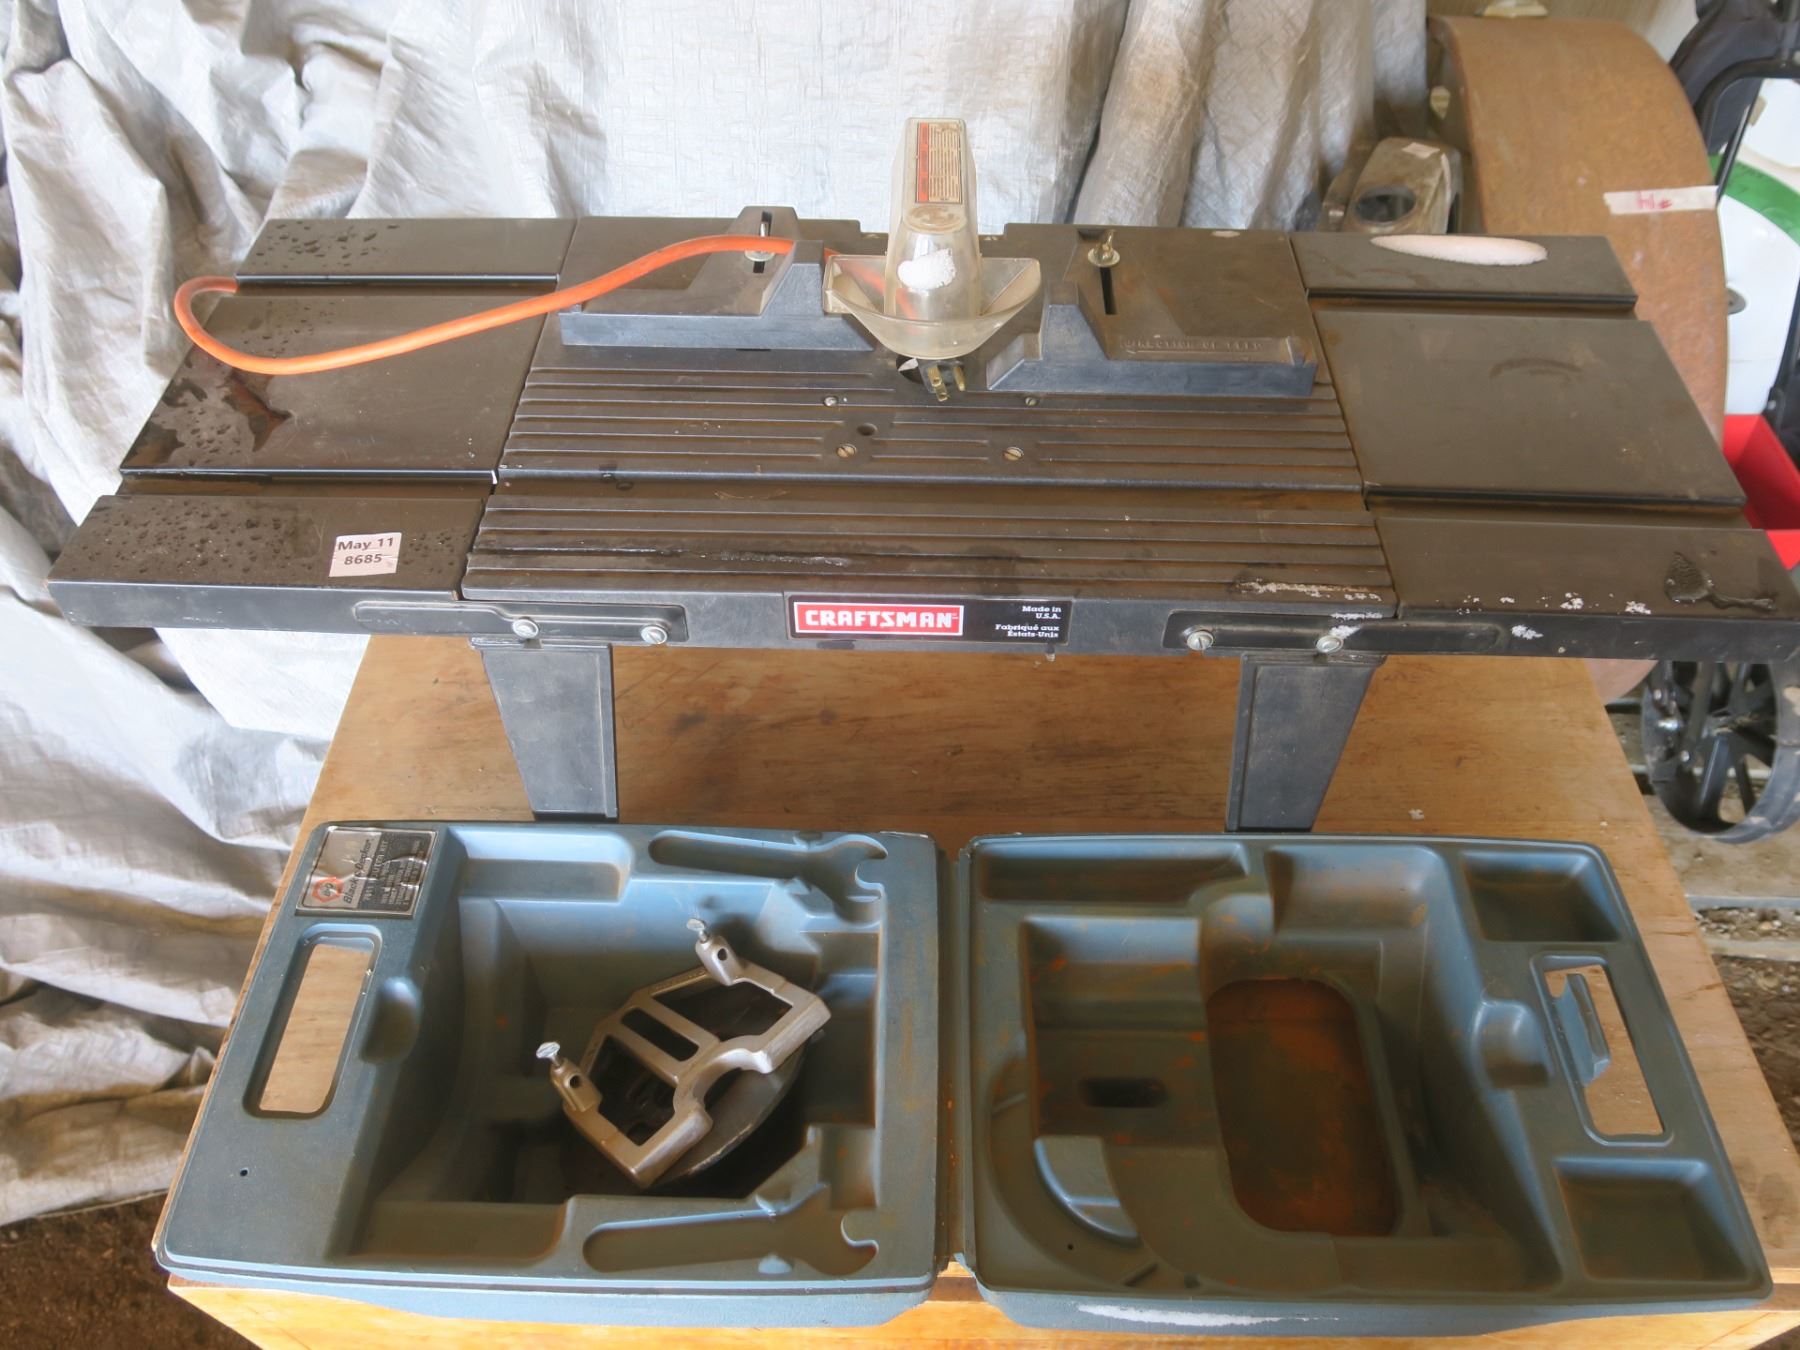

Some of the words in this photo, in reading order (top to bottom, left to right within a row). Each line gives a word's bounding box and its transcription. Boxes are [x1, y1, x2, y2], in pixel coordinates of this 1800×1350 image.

[338, 541, 372, 551] May
[378, 537, 394, 547] 11
[344, 553, 382, 566] 8685
[805, 609, 953, 628] CRAFTSMAN
[995, 623, 1039, 631] Fabriqué
[343, 876, 360, 904] Black
